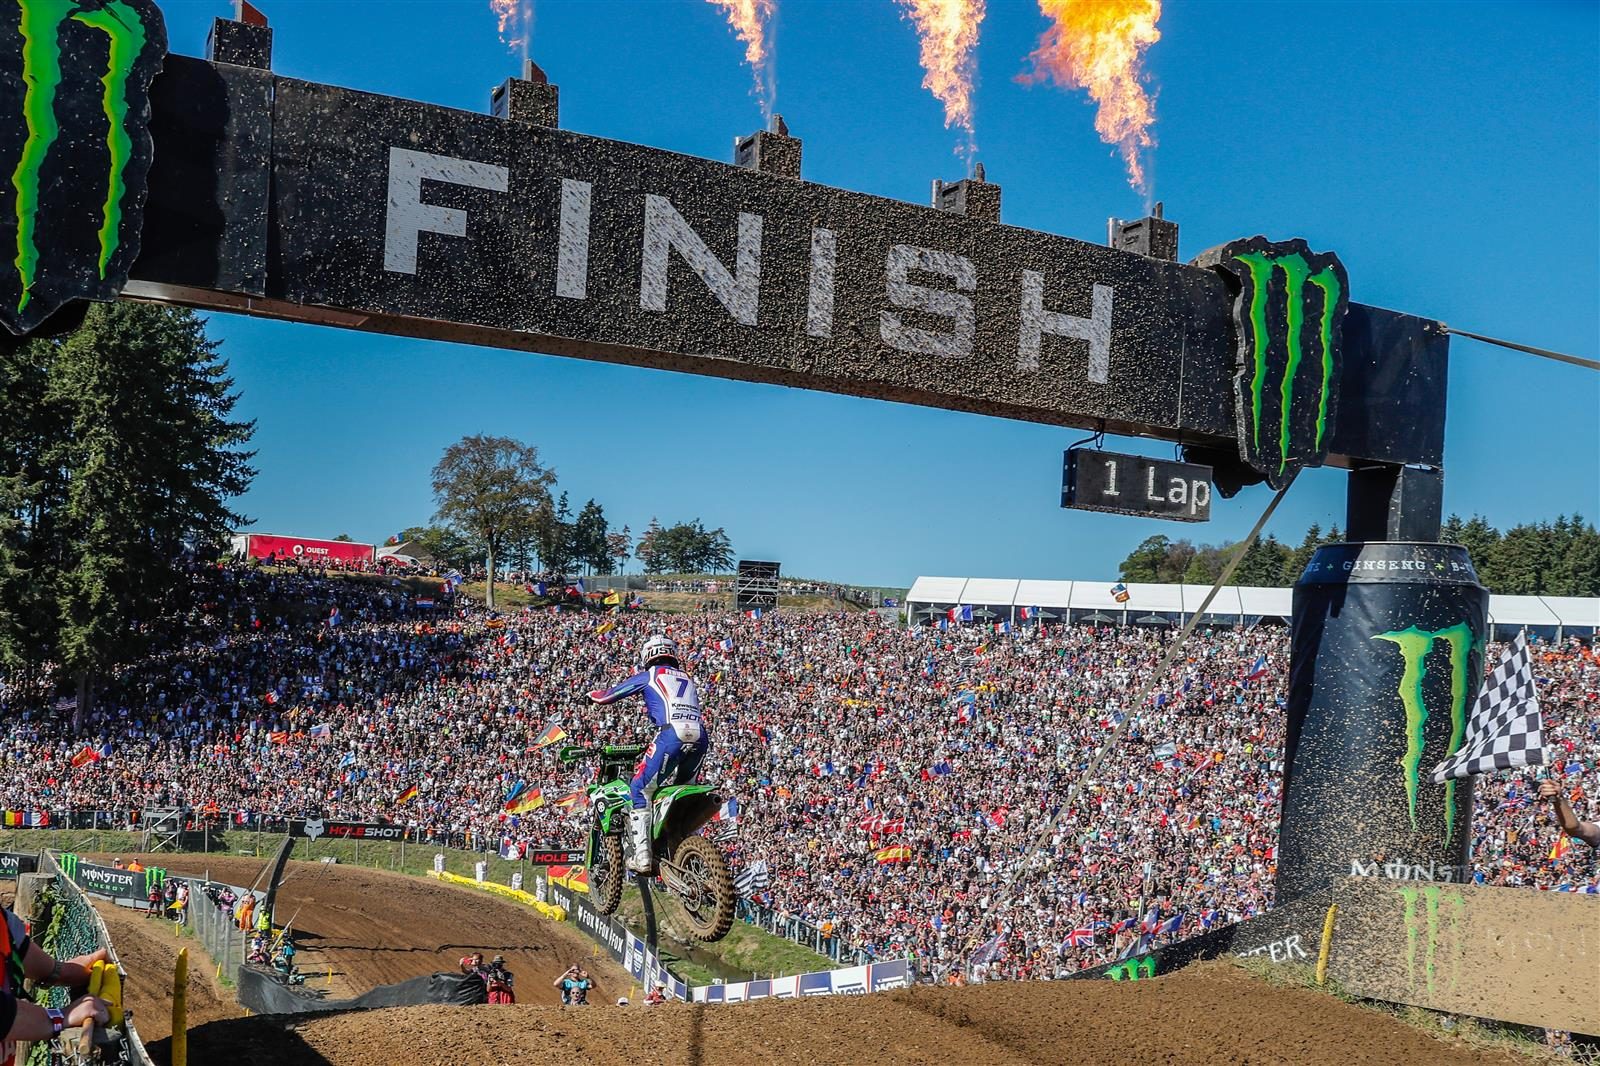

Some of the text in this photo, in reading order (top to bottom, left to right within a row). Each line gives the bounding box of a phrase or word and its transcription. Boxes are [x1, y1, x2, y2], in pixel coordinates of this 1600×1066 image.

[382, 146, 1114, 385] FINISH
[1103, 460, 1210, 515] 1 Lap
[1343, 560, 1426, 571] GINSENG
[676, 678, 688, 697] 7
[329, 826, 402, 838] HOLESHOT
[81, 868, 133, 886] MONSTER
[88, 881, 125, 892] ENERGY
[560, 894, 571, 912] FOX
[582, 907, 594, 928] FOX
[598, 921, 610, 942] FOX
[611, 934, 624, 953] FOX
